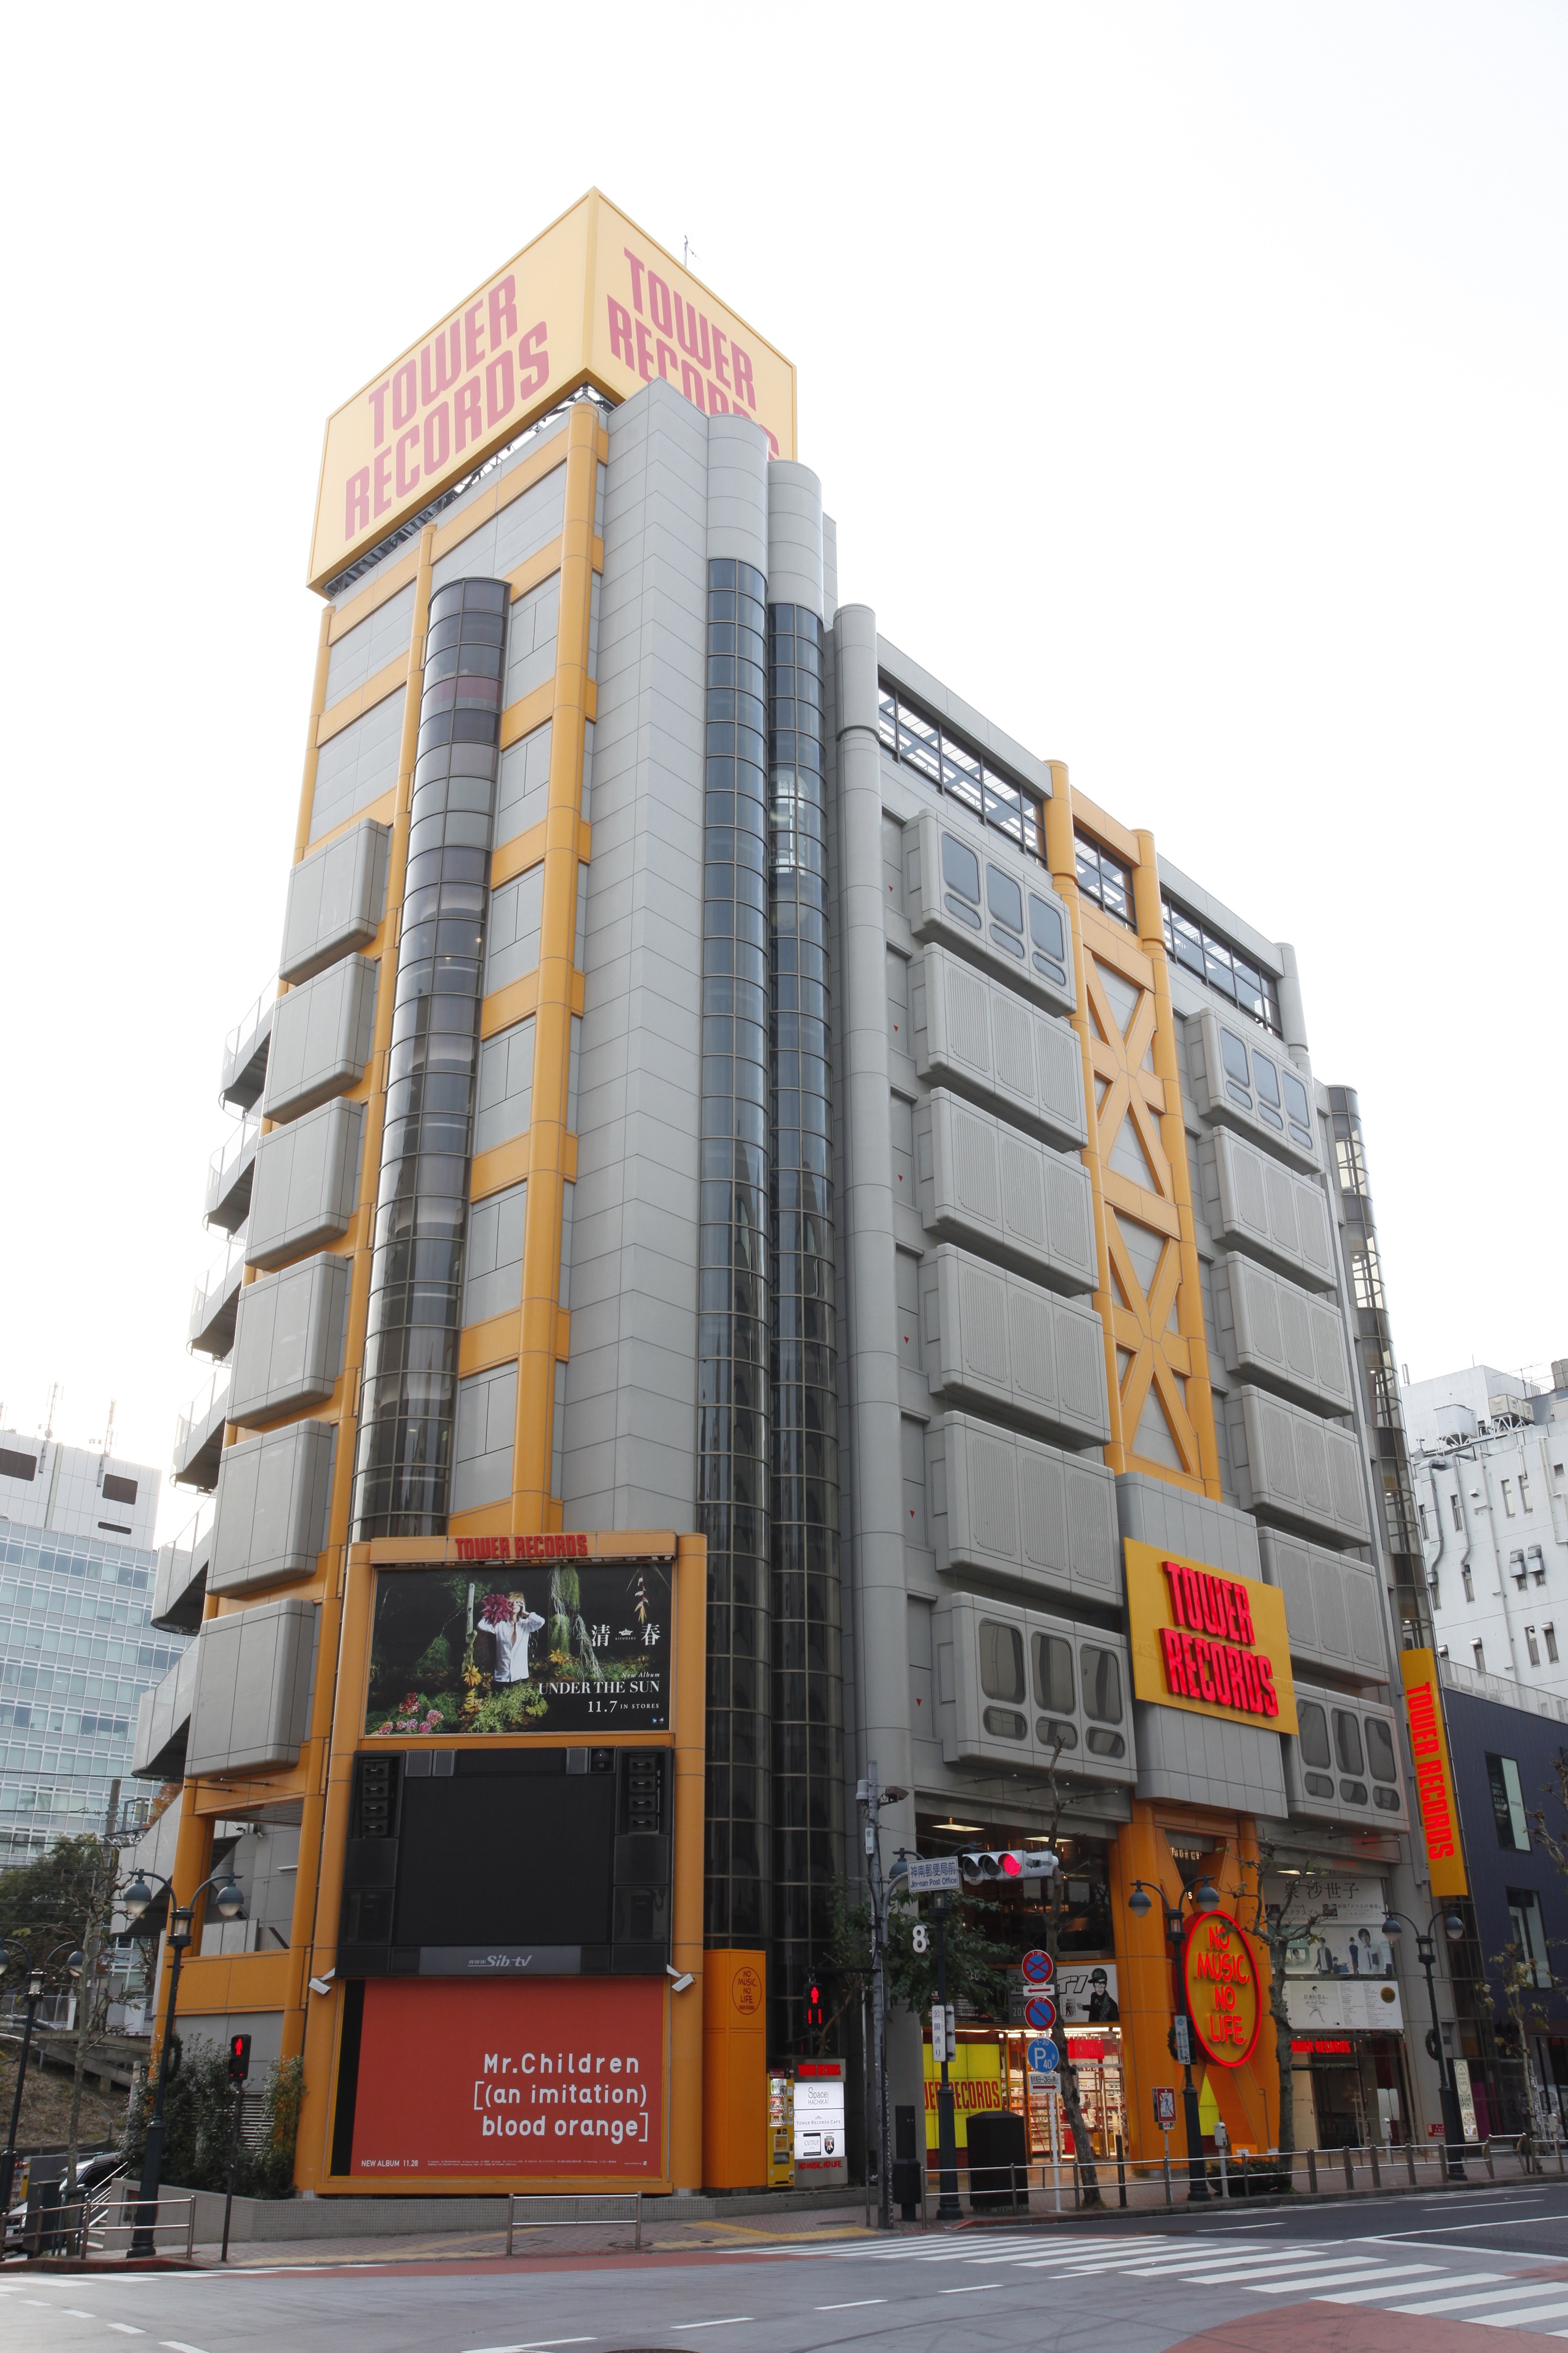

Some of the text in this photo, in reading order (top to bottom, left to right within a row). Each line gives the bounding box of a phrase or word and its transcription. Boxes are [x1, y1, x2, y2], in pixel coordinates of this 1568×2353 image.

[623, 246, 756, 412] TOWER
[368, 274, 518, 449] TOWER
[345, 321, 549, 542] RECORDS
[455, 1535, 588, 1559] TOWER RECORDS
[1162, 1561, 1255, 1646] TOWER
[591, 1624, 661, 1647] 清 春
[1159, 1628, 1279, 1717] RECORDS
[539, 1681, 660, 1695] UNDER THE SUN
[588, 1700, 618, 1713] 11.7
[1407, 1682, 1454, 1860] TOWER RECORDS
[910, 1861, 956, 1878] 神南郵便局前
[910, 1879, 928, 1888] Jin-nan
[942, 1877, 957, 1885] Office
[913, 1925, 930, 1953] 8
[1209, 1925, 1230, 1950] NO
[1215, 1986, 1236, 2011] NO
[933, 2009, 942, 2057] 公園通り
[1210, 2014, 1247, 2044] LIFE.
[1034, 2048, 1046, 2069] P
[1315, 2041, 1351, 2053] RECORDS
[484, 2053, 639, 2074] Mr.Children
[1043, 2060, 1052, 2069] 40
[532, 2085, 646, 2107] imitation)
[808, 2087, 828, 2099] Space
[482, 2112, 648, 2145] blood orange]
